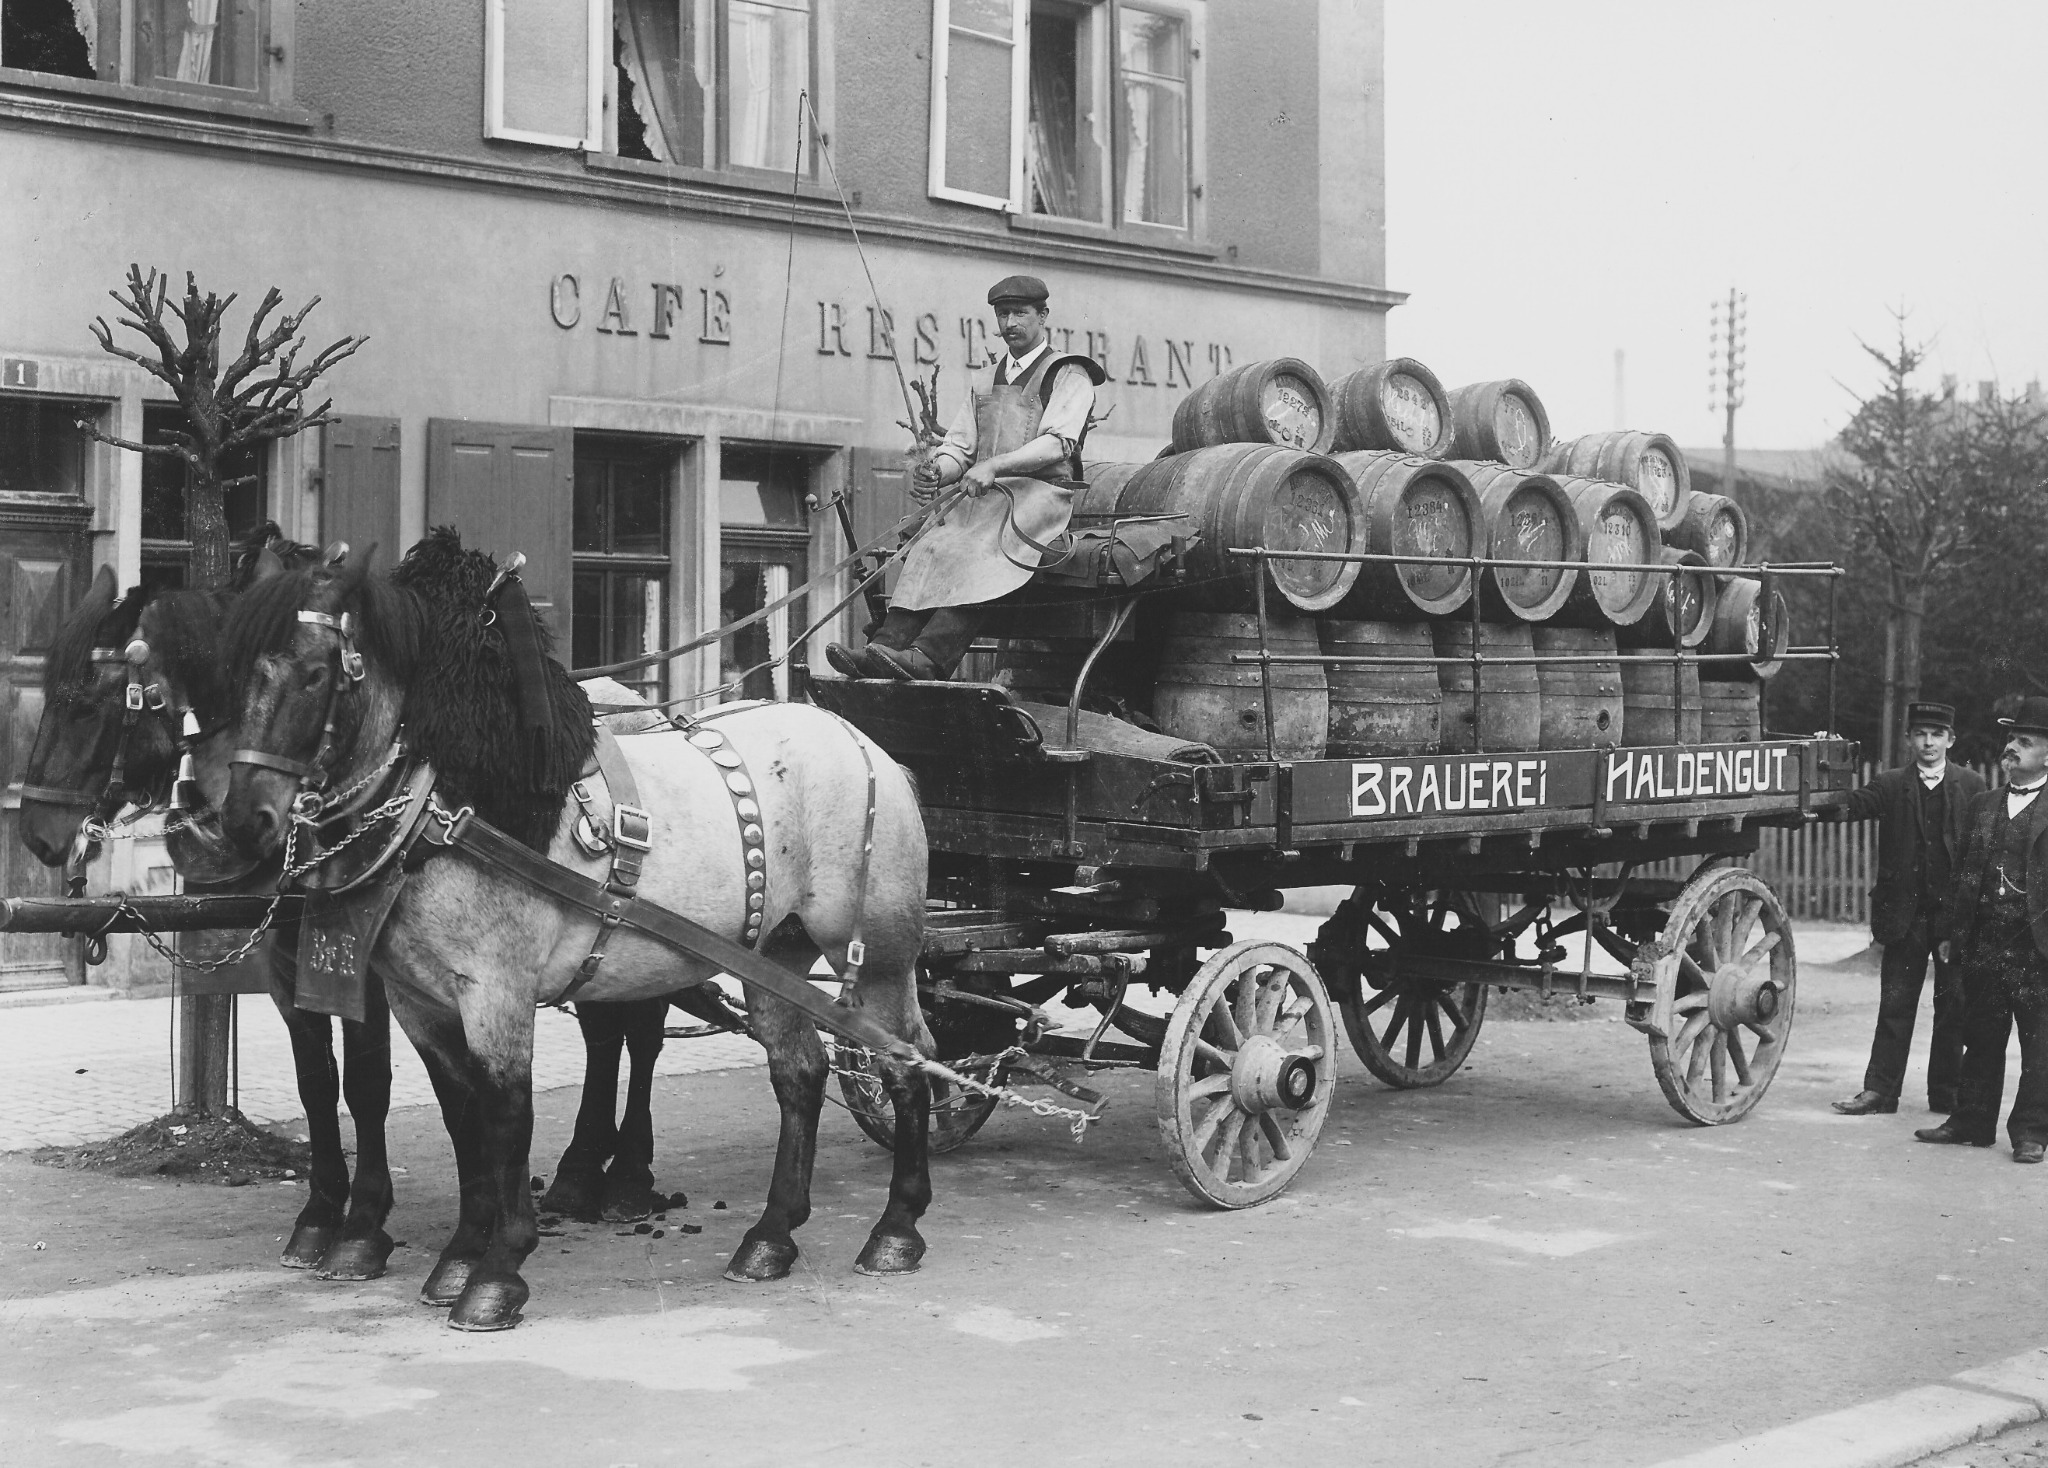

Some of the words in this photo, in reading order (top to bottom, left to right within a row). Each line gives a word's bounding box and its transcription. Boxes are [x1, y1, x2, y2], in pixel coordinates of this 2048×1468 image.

[550, 264, 731, 346] CAFÉ
[818, 301, 1231, 389] RESTURANT
[16, 362, 26, 385] 1
[1606, 748, 1788, 802] HALDENGUT
